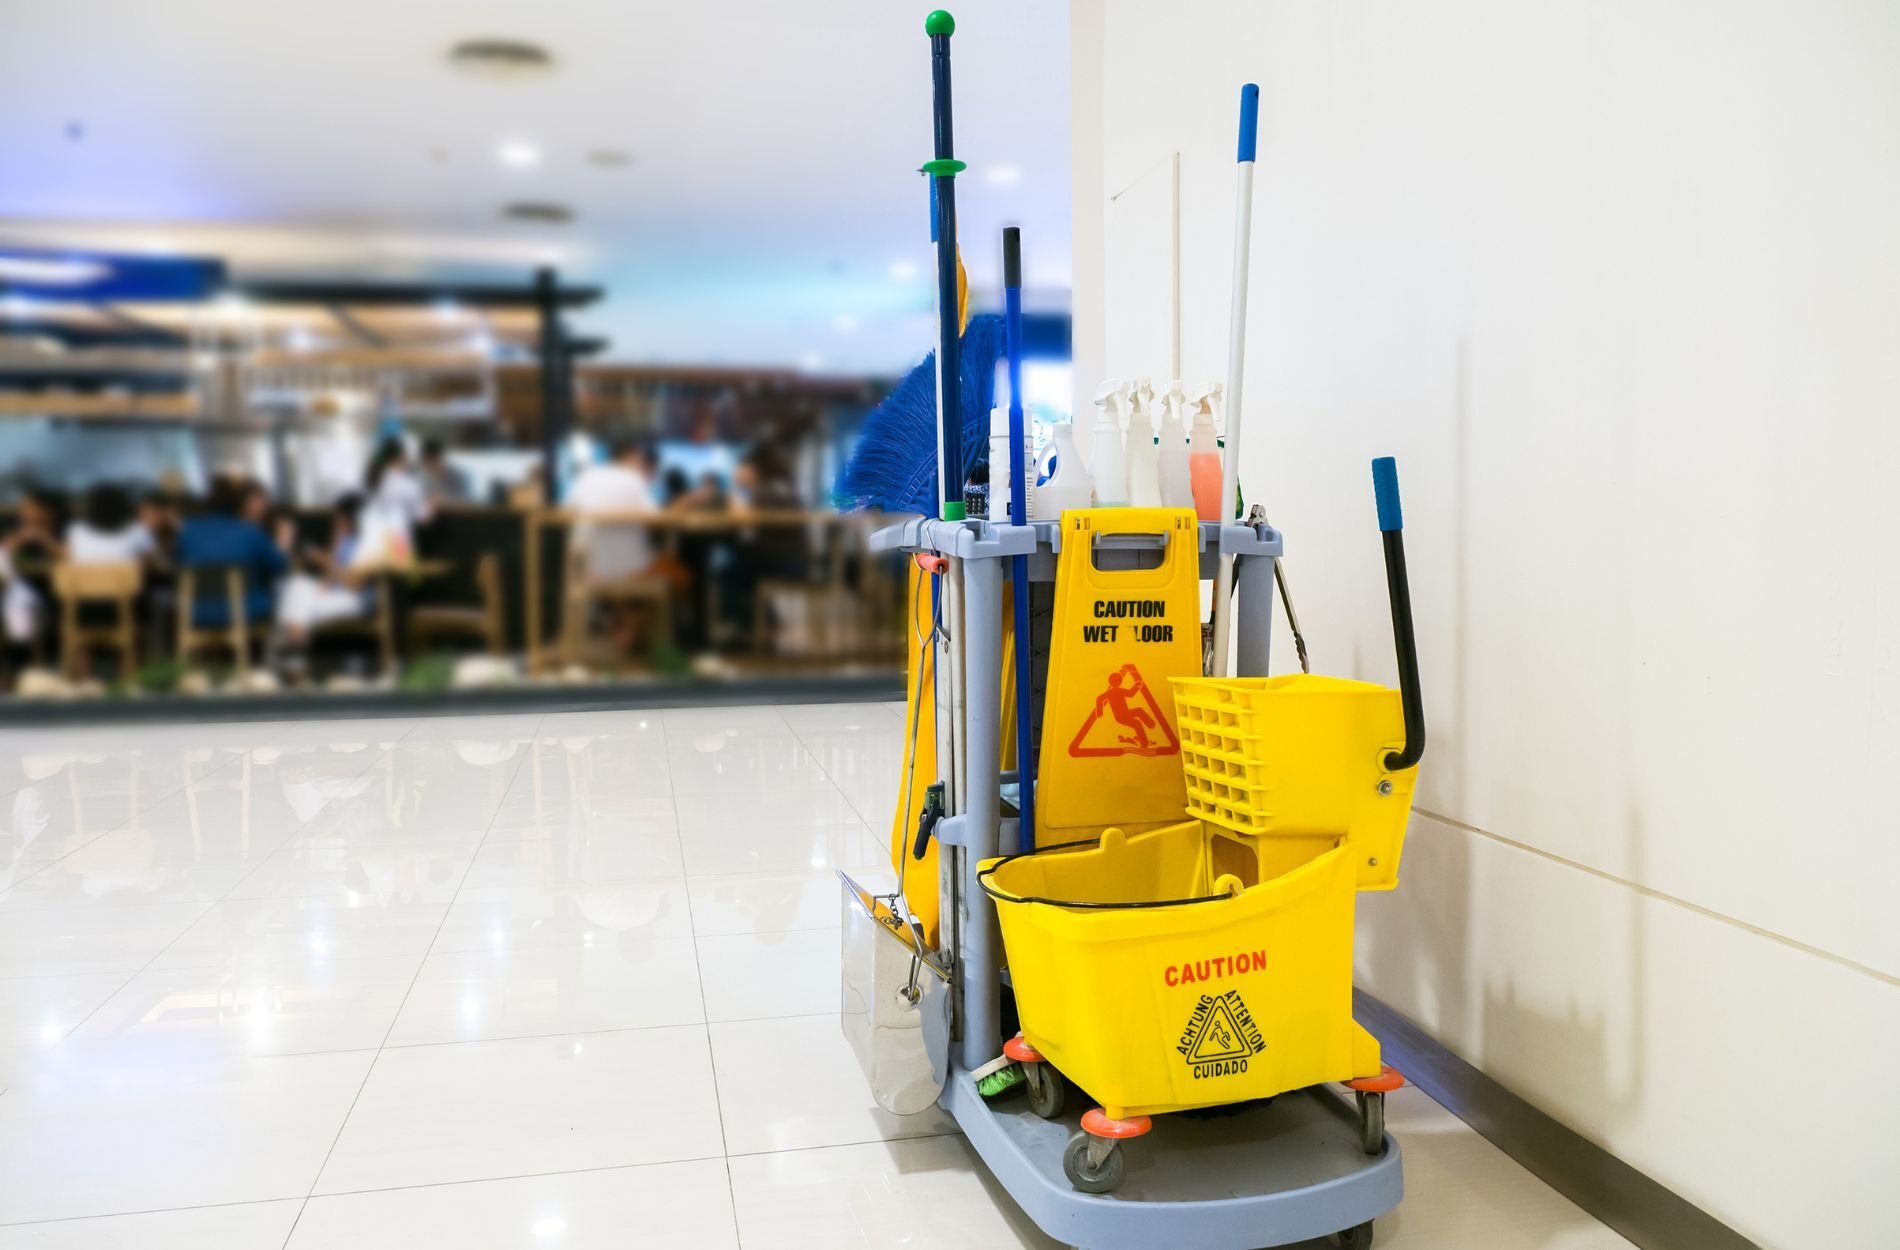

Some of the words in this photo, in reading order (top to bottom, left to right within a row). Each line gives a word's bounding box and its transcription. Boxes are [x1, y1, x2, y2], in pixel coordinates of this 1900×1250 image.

[1094, 600, 1165, 618] CAUTION
[1083, 625, 1119, 642] WET
[1129, 625, 1173, 642] LOOR
[1164, 950, 1267, 987] CAUTION
[1176, 994, 1213, 1056] ACHTUNG
[1224, 989, 1267, 1054] ATTENTION
[1194, 1059, 1248, 1080] CUIDADO
